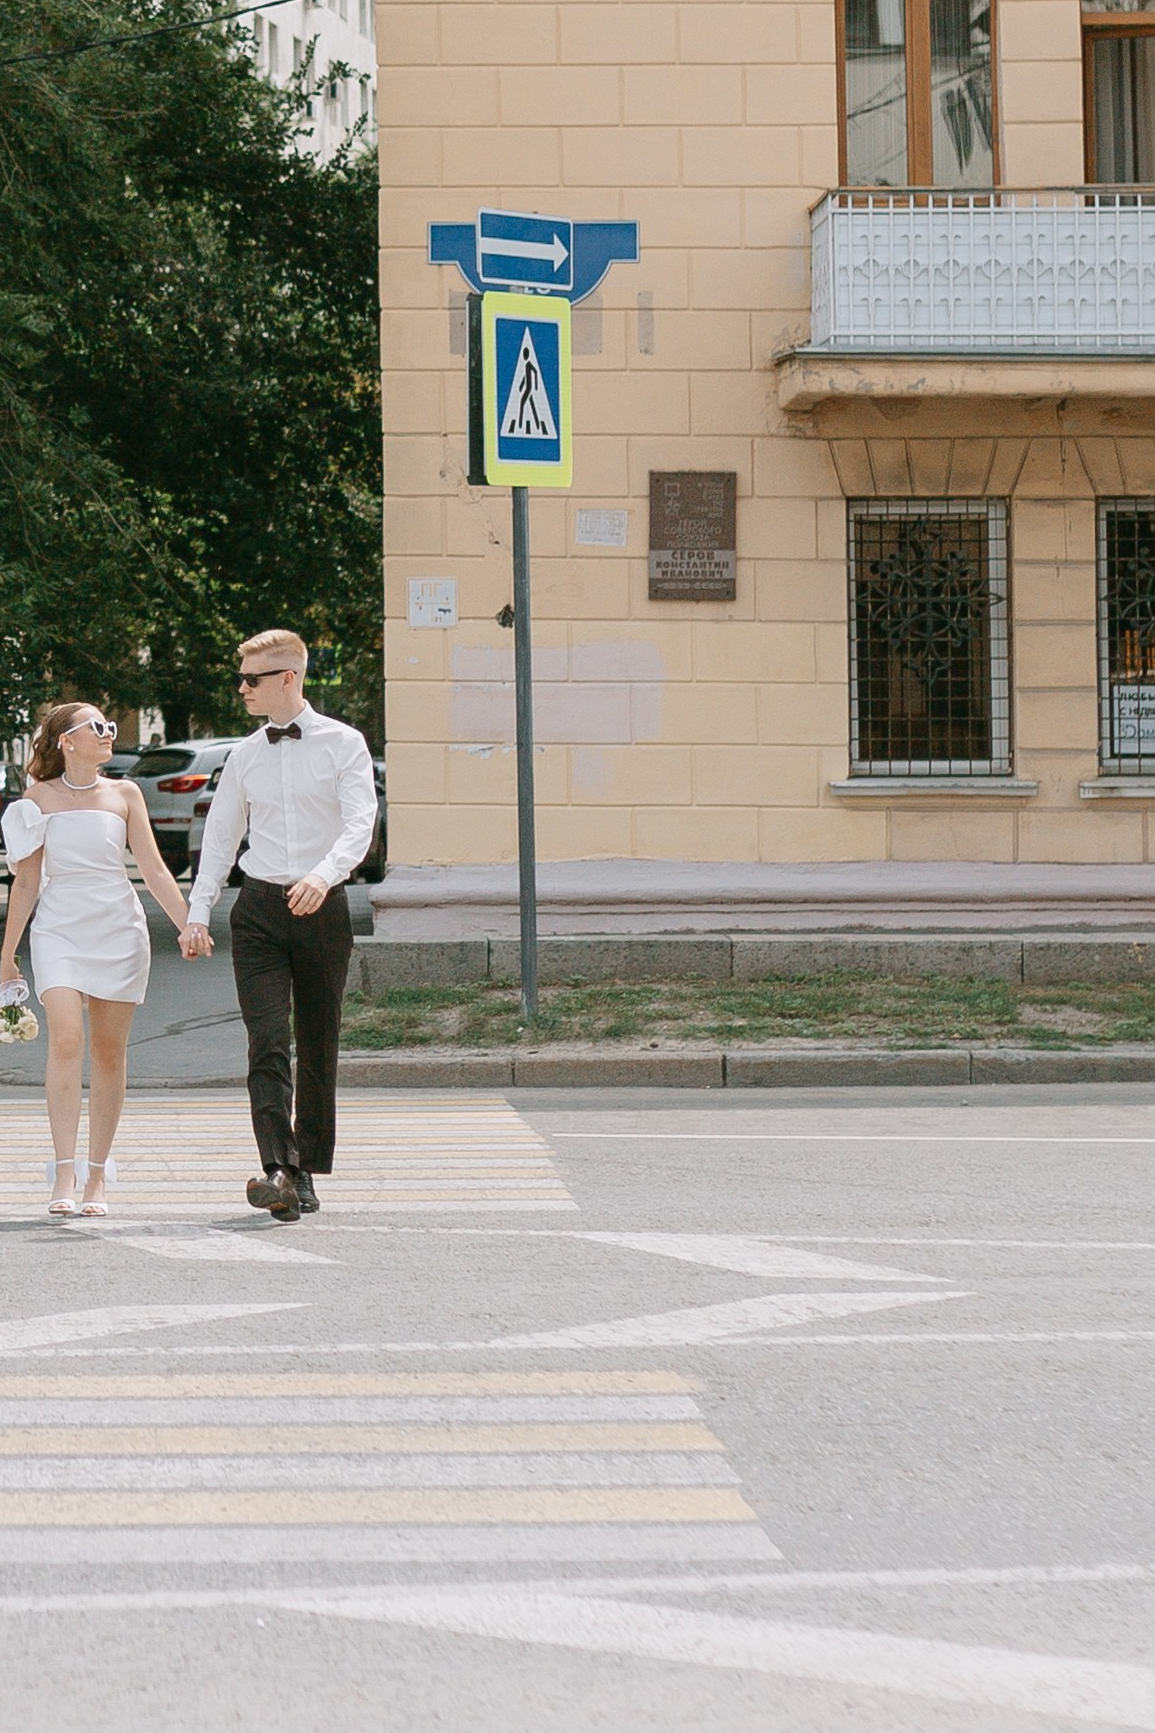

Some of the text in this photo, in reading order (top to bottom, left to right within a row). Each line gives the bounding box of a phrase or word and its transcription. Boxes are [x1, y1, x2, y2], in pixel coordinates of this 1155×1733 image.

[671, 551, 716, 560] СЕРОВ
[655, 561, 730, 570] КОНСТАНТИН
[661, 570, 723, 578] ИВАНОВИЧ
